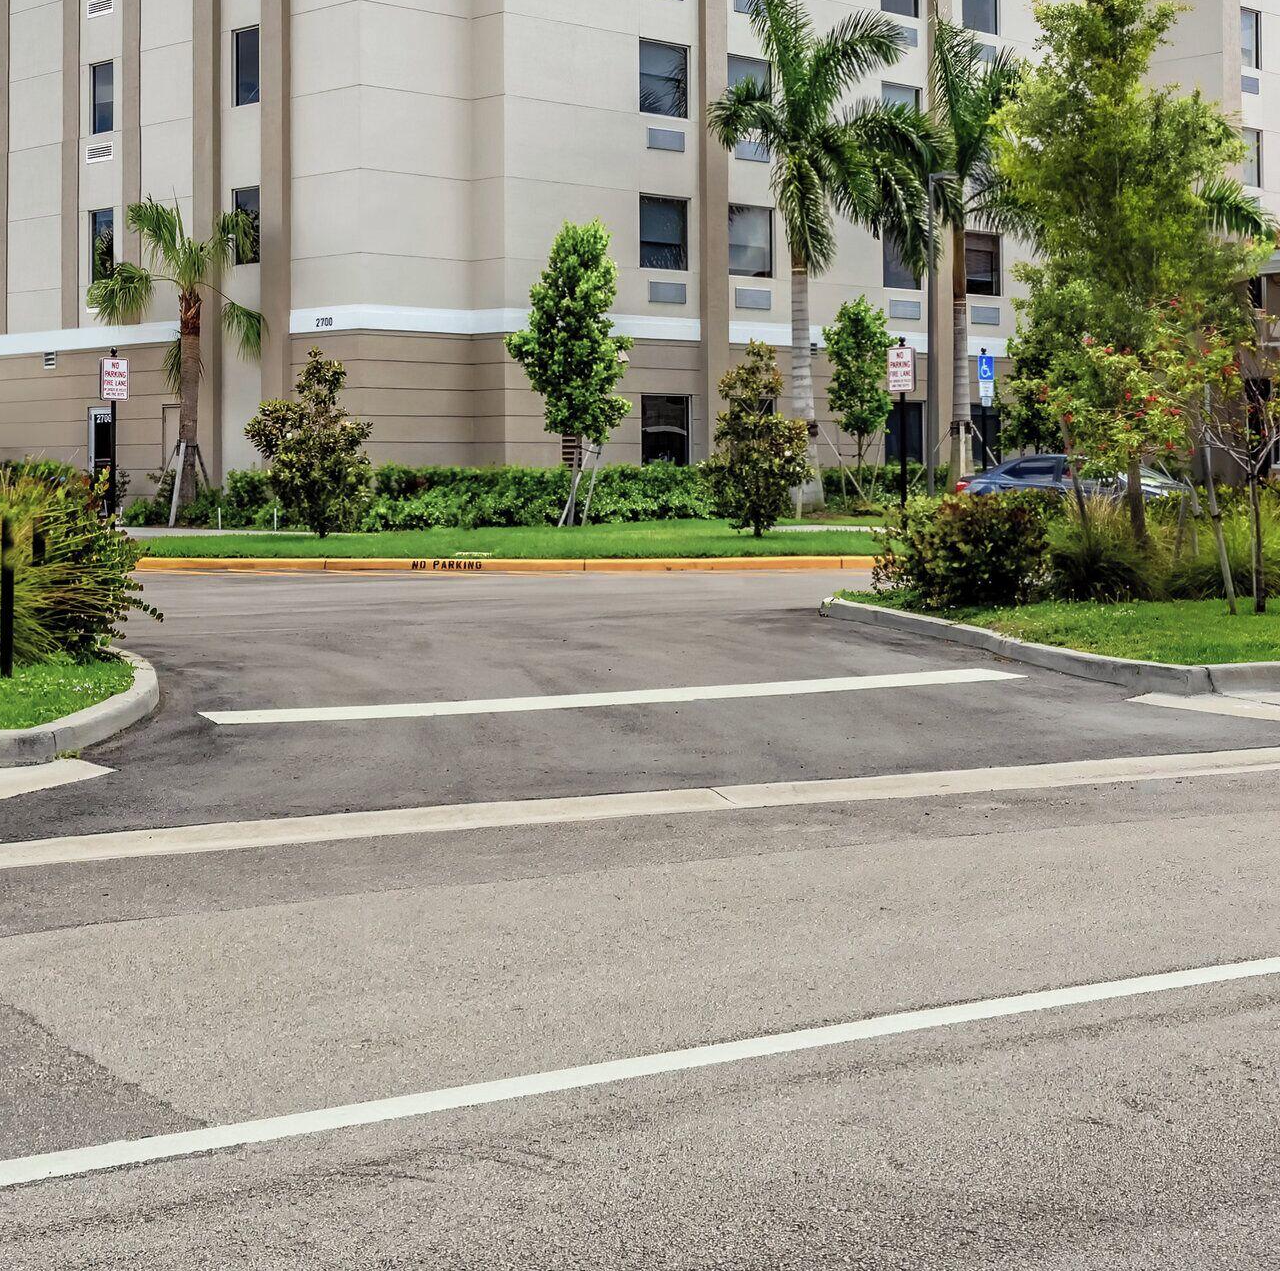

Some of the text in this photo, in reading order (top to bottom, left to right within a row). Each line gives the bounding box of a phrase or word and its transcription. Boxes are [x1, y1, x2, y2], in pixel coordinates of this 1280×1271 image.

[315, 317, 333, 328] 2700
[896, 351, 904, 359] NO
[111, 362, 120, 370] NO
[890, 361, 911, 369] PARKING
[104, 370, 127, 379] PARKING
[411, 560, 482, 570] NO PARKING
